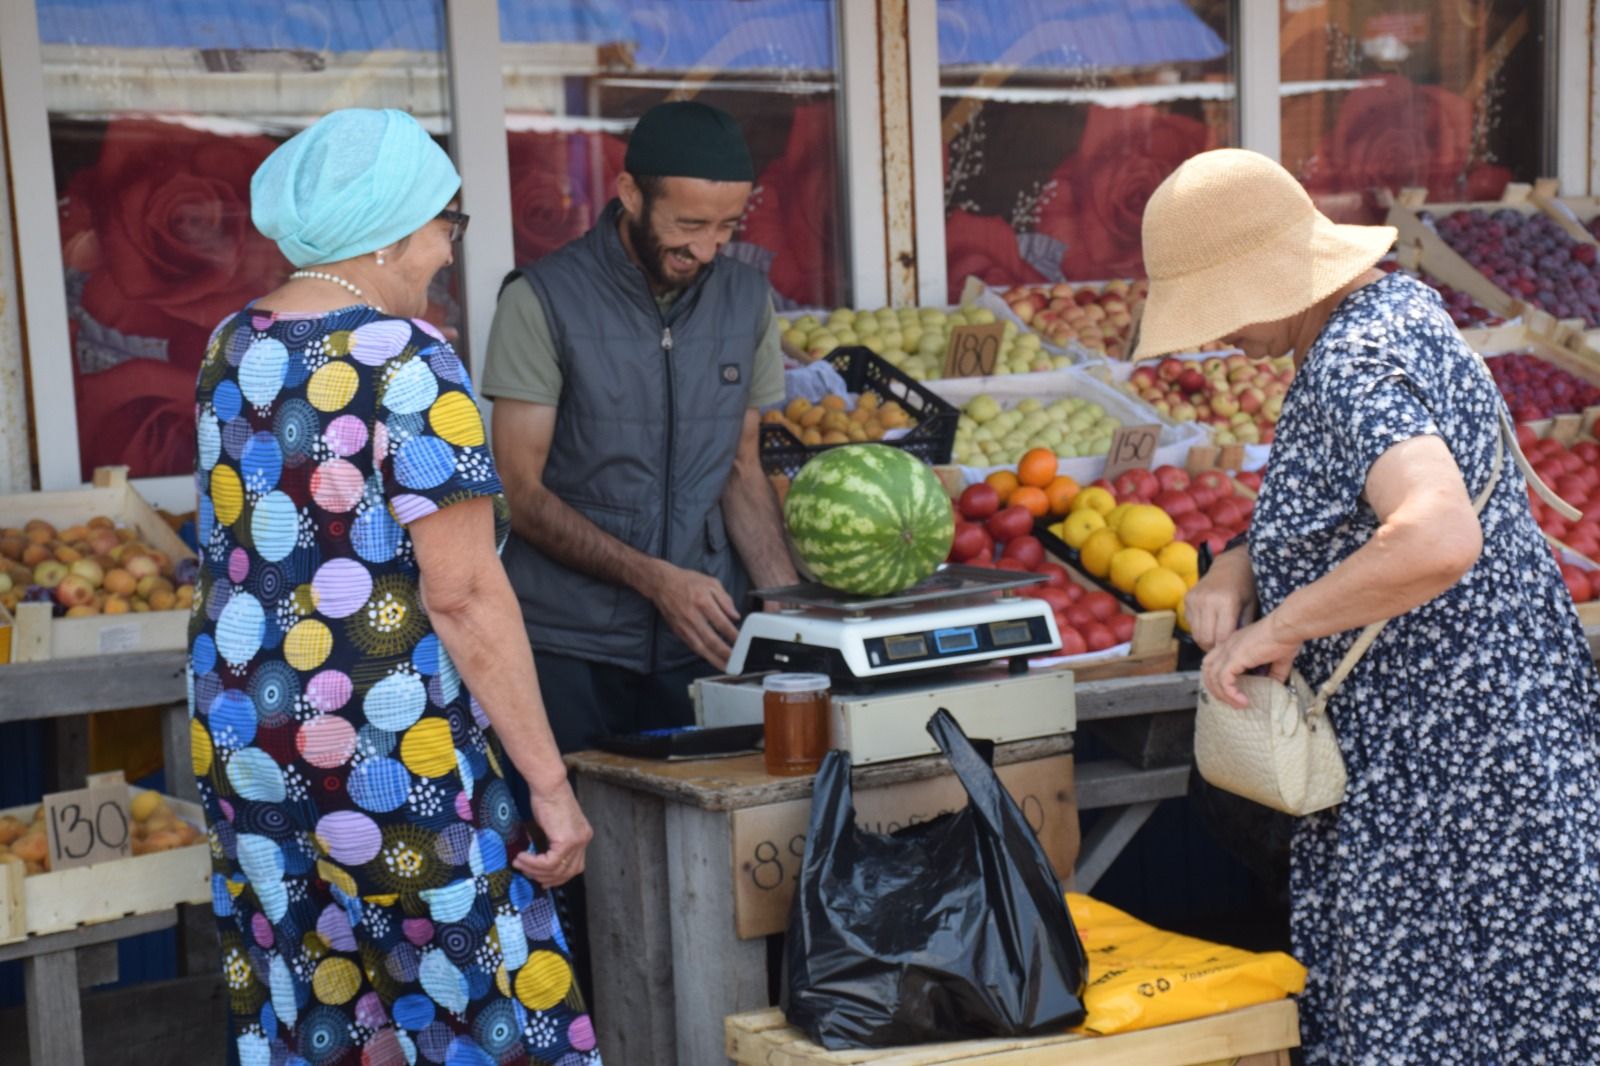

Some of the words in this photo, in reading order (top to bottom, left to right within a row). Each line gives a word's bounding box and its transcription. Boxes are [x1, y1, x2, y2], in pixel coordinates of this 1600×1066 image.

[952, 333, 998, 376] 180
[1114, 430, 1156, 465] 150
[51, 801, 129, 861] 130
